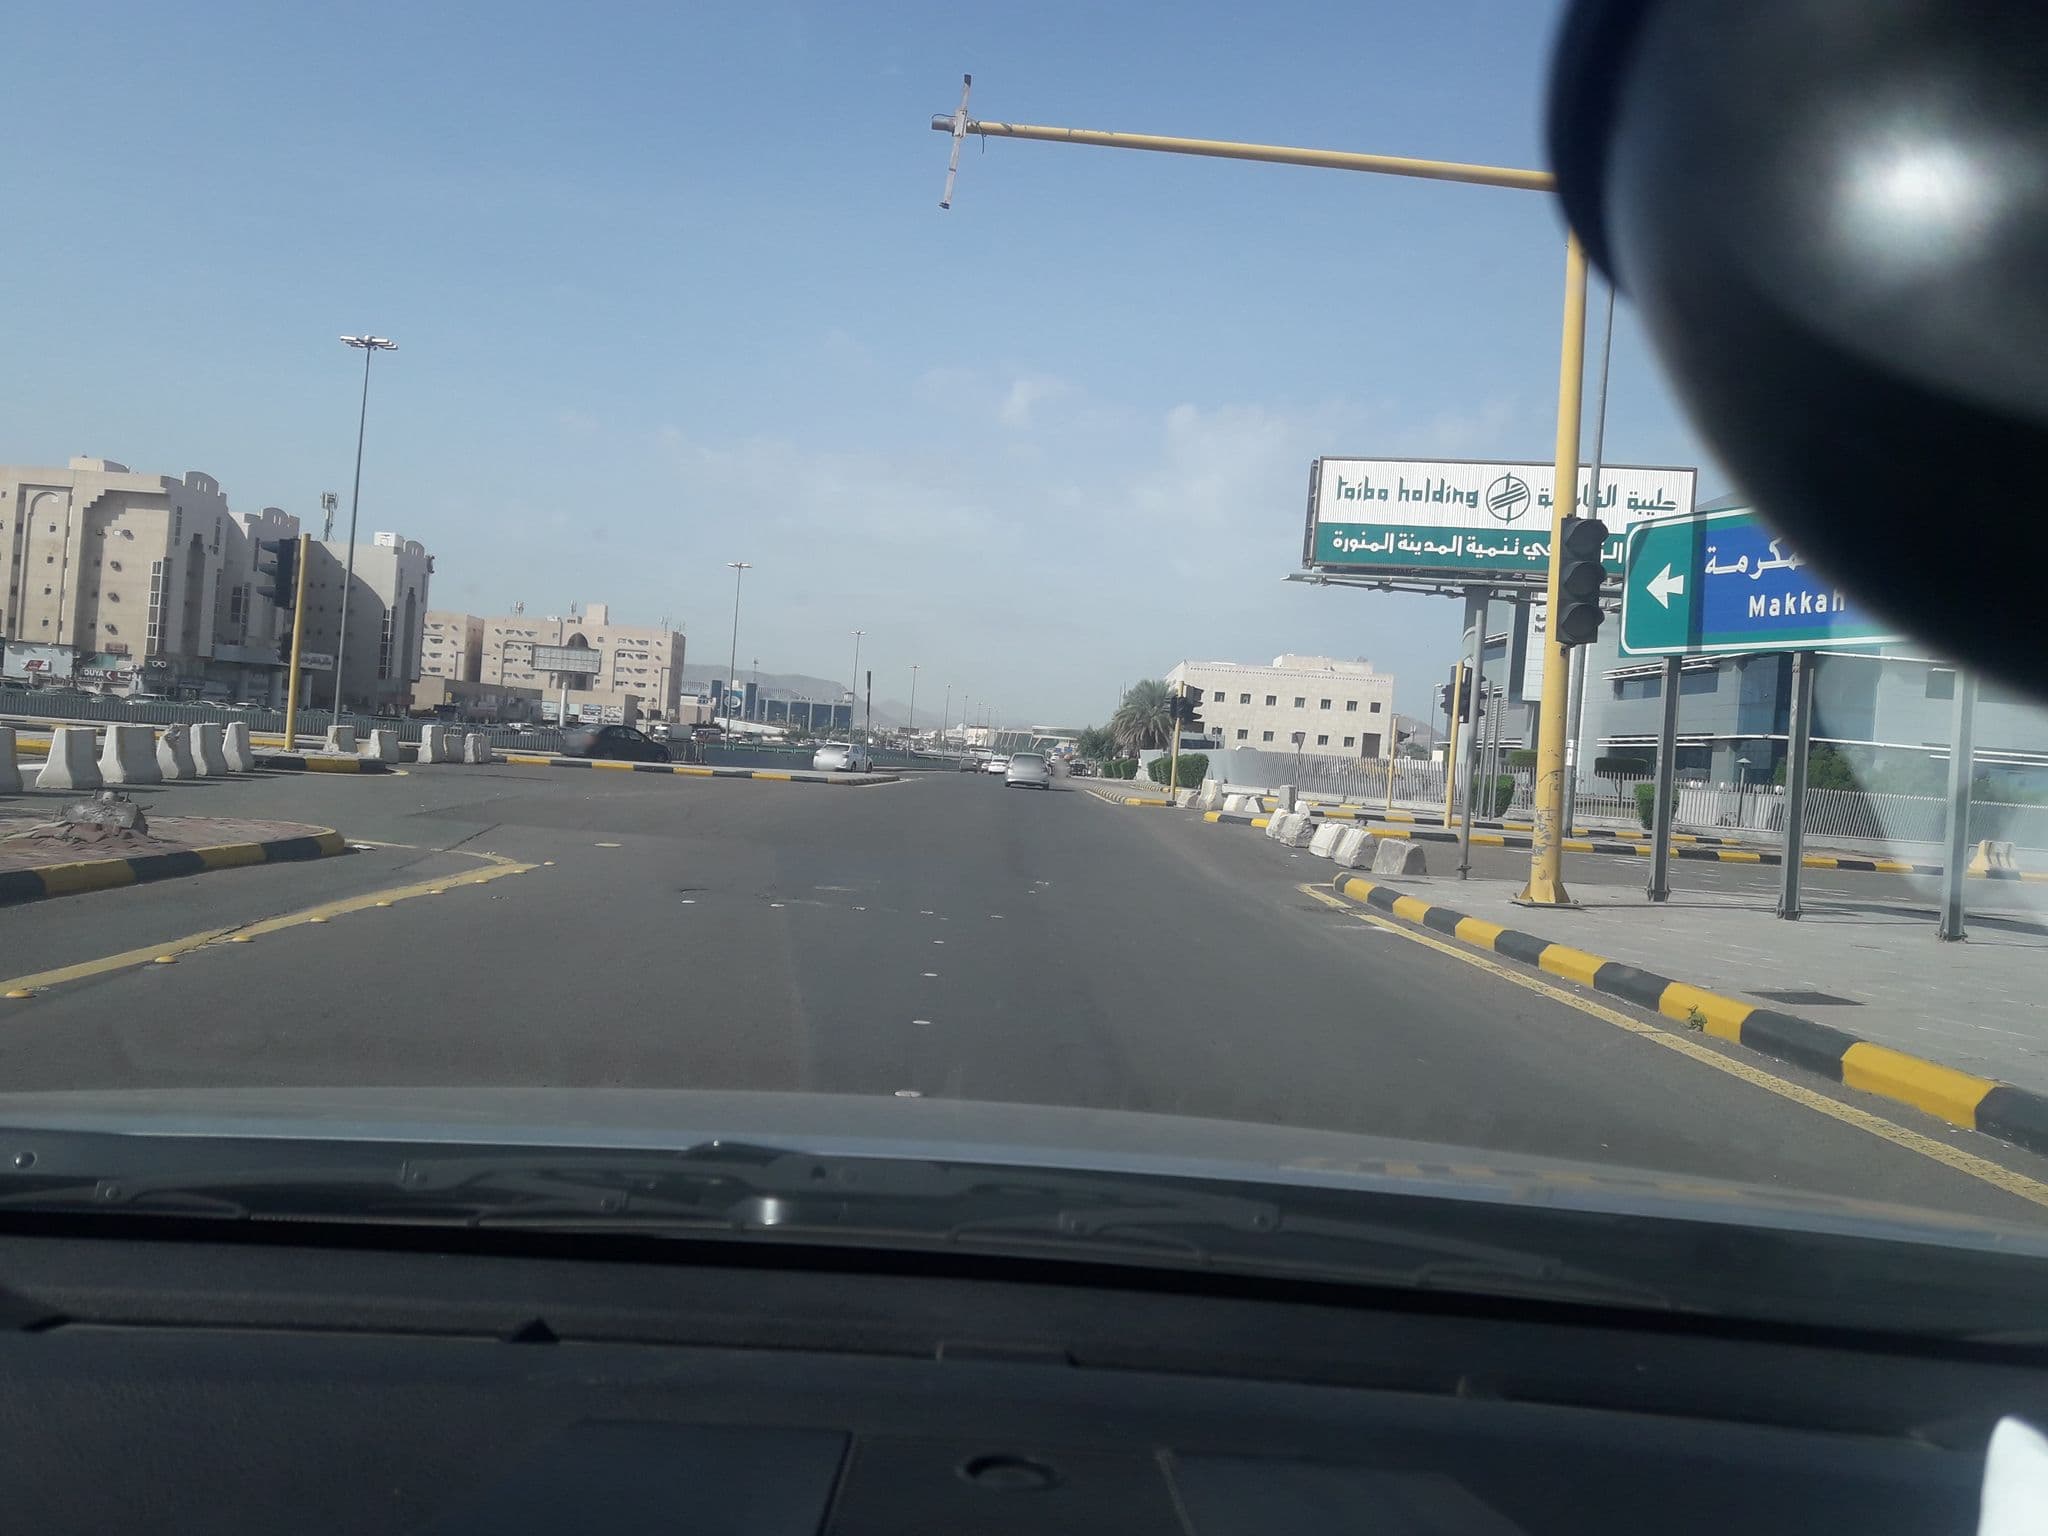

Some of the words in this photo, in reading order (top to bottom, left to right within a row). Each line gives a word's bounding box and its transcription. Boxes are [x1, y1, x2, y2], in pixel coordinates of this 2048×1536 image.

[1398, 475, 1479, 509] holding
[1627, 487, 1677, 516] طيبة
[1333, 530, 1394, 554] المنورة
[1398, 532, 1462, 557] المدينة
[1466, 535, 1520, 559] تنمية
[1749, 588, 1846, 619] Makkah
